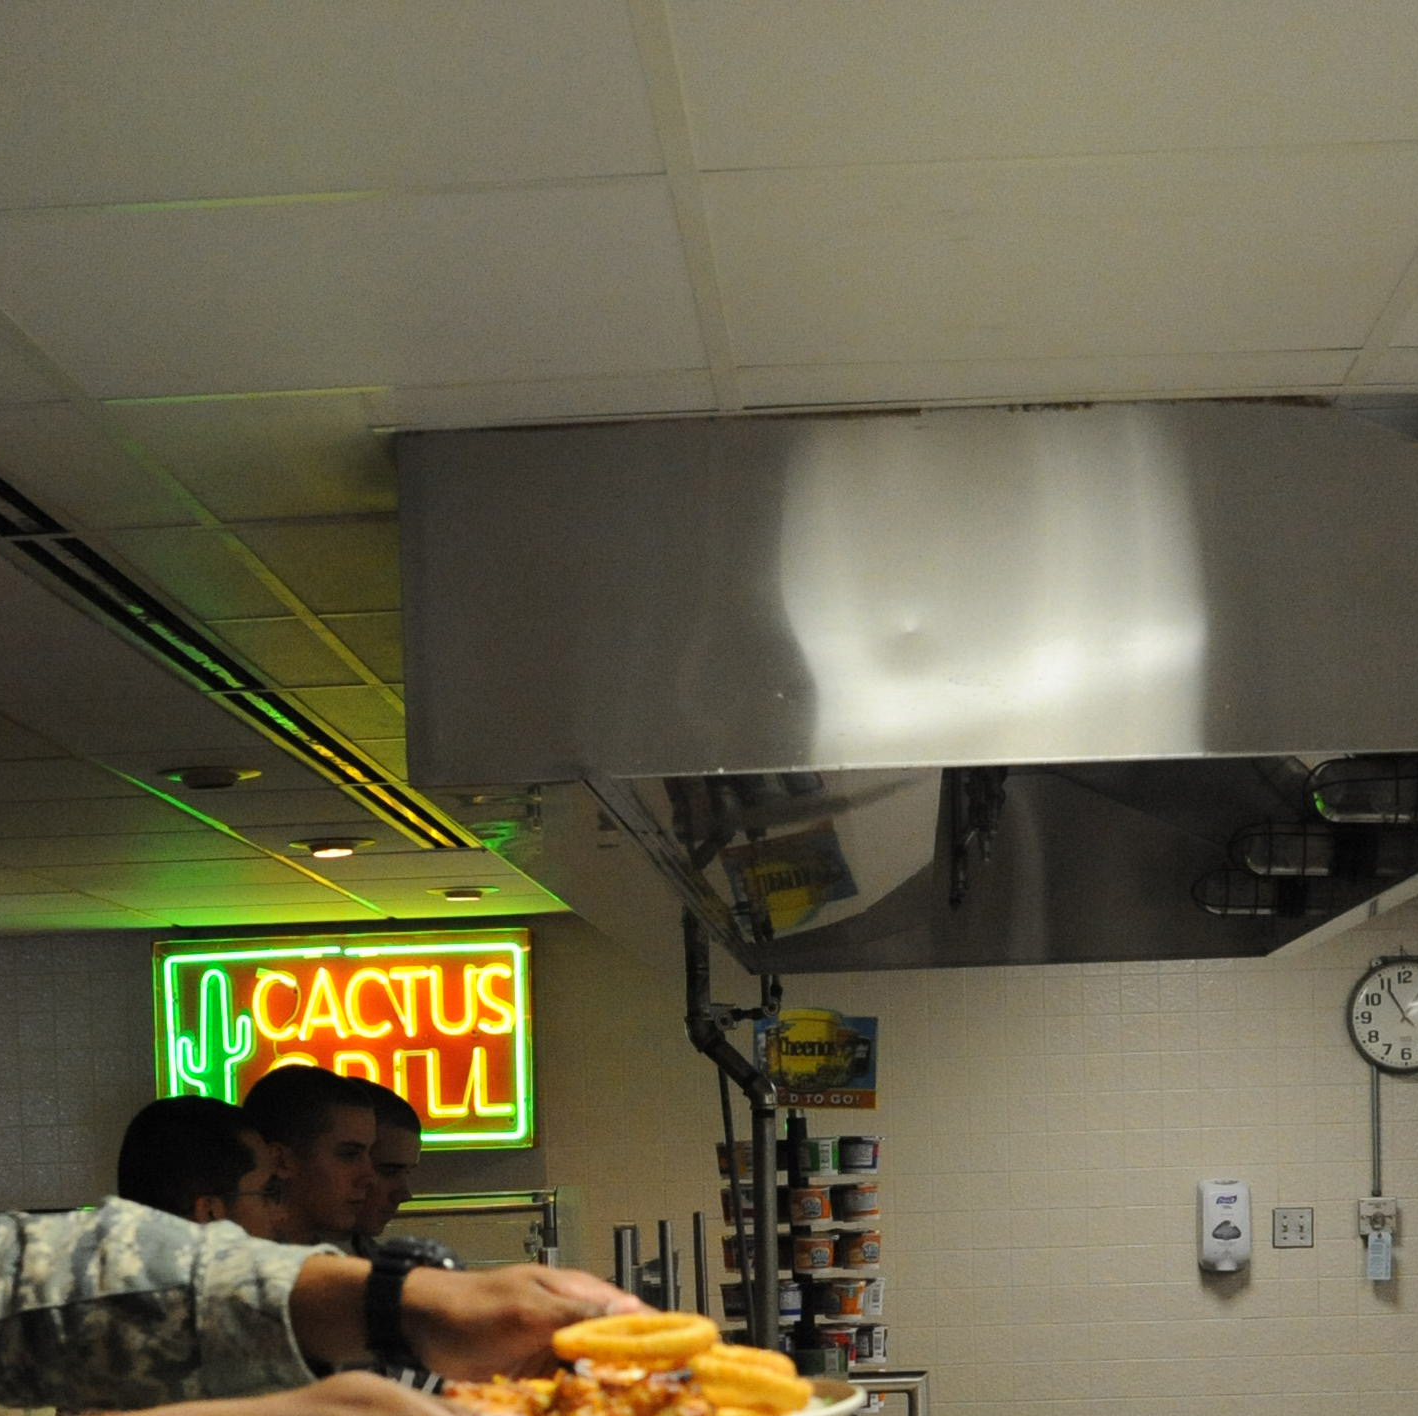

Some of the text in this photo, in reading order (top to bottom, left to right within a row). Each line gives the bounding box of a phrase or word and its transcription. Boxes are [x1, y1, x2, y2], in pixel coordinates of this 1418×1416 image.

[1397, 970, 1412, 984] 12
[252, 962, 516, 1041] CACTUS
[1365, 992, 1381, 1006] 10
[1361, 1011, 1372, 1024] 9
[1368, 1030, 1379, 1043] 8
[1382, 1043, 1392, 1055] 7
[1401, 1048, 1412, 1060] 6
[268, 1046, 517, 1119] ILL
[806, 1094, 824, 1104] TO
[830, 1094, 860, 1104] GO!
